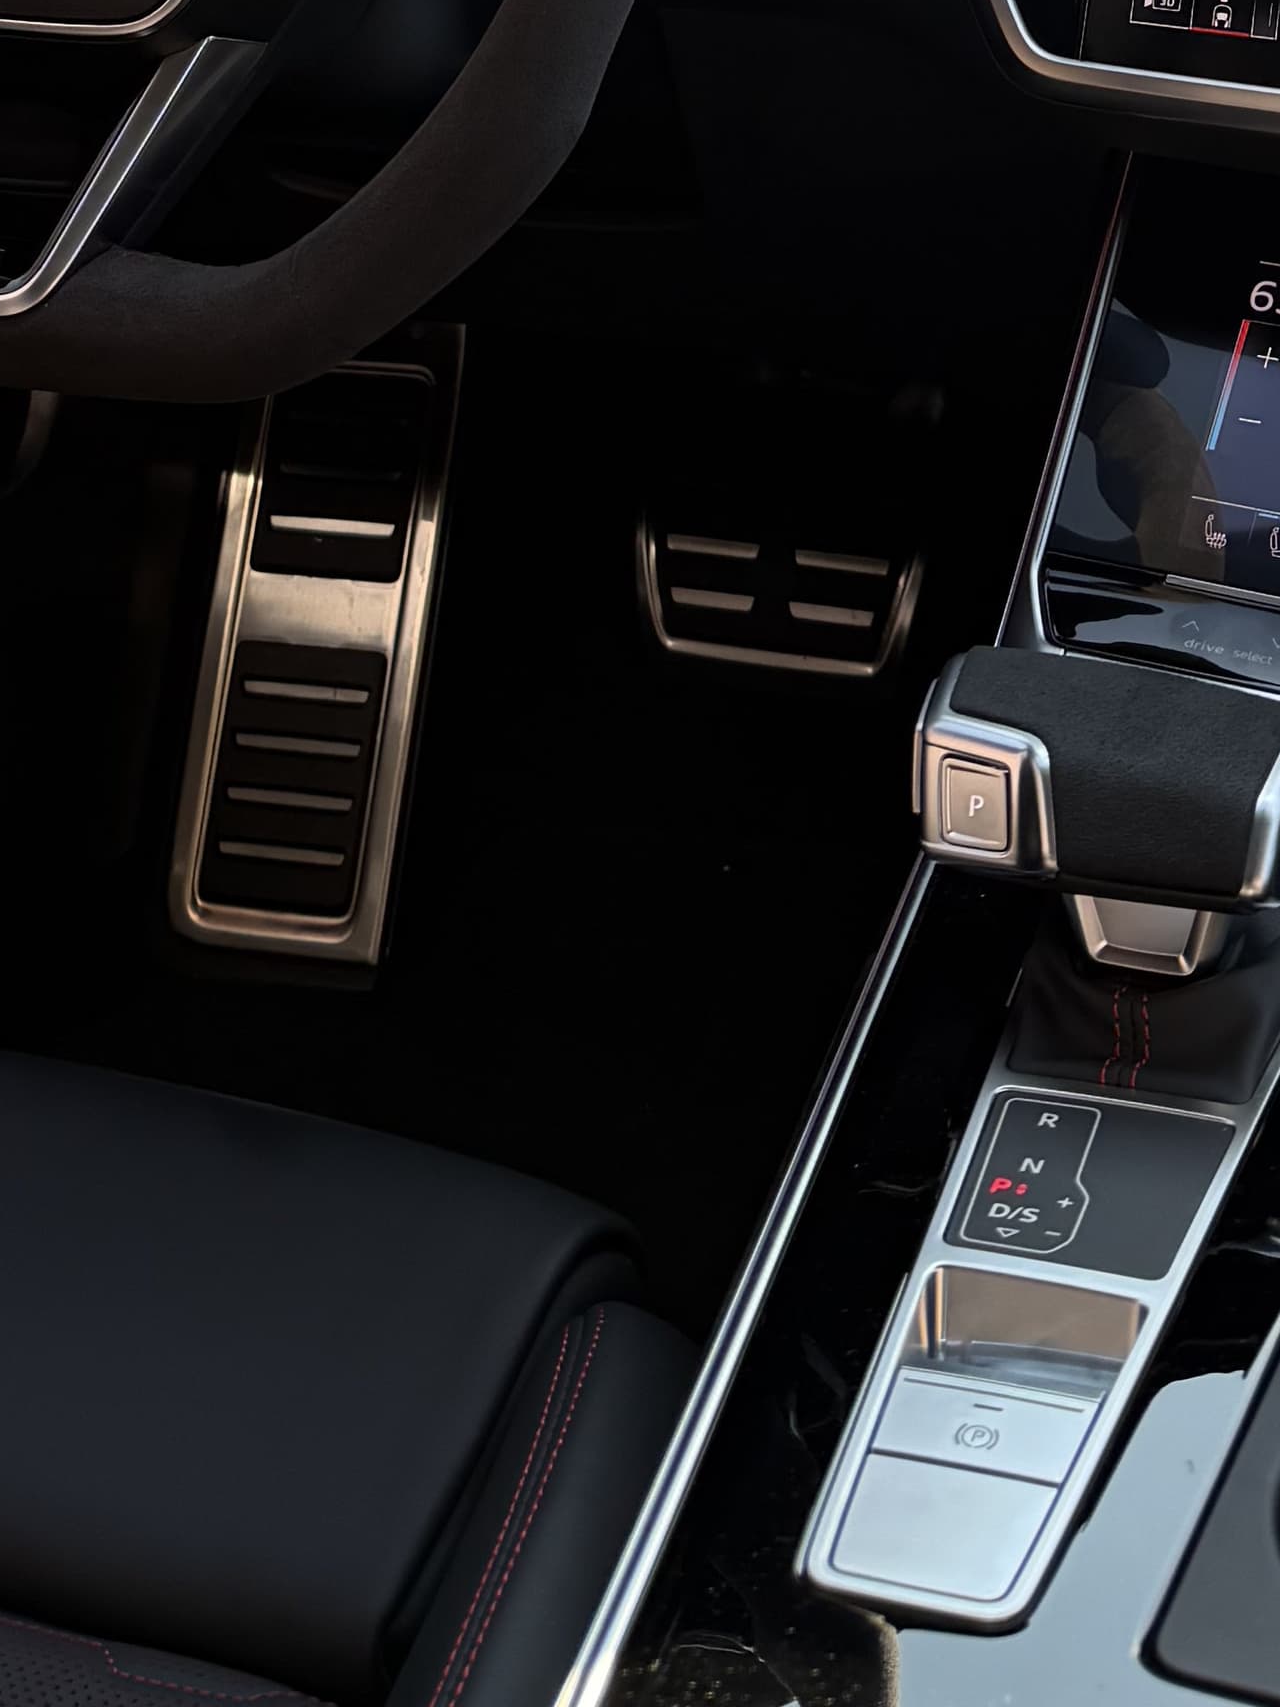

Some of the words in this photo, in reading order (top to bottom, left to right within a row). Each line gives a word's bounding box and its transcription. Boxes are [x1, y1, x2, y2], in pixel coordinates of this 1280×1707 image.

[1183, 639, 1225, 655] drive
[1232, 648, 1273, 667] select
[968, 795, 985, 817] P
[1037, 1112, 1060, 1128] R
[1020, 1157, 1045, 1174] N
[989, 1177, 1013, 1194] P
[988, 1202, 1040, 1224] D/S
[970, 1429, 987, 1443] P
